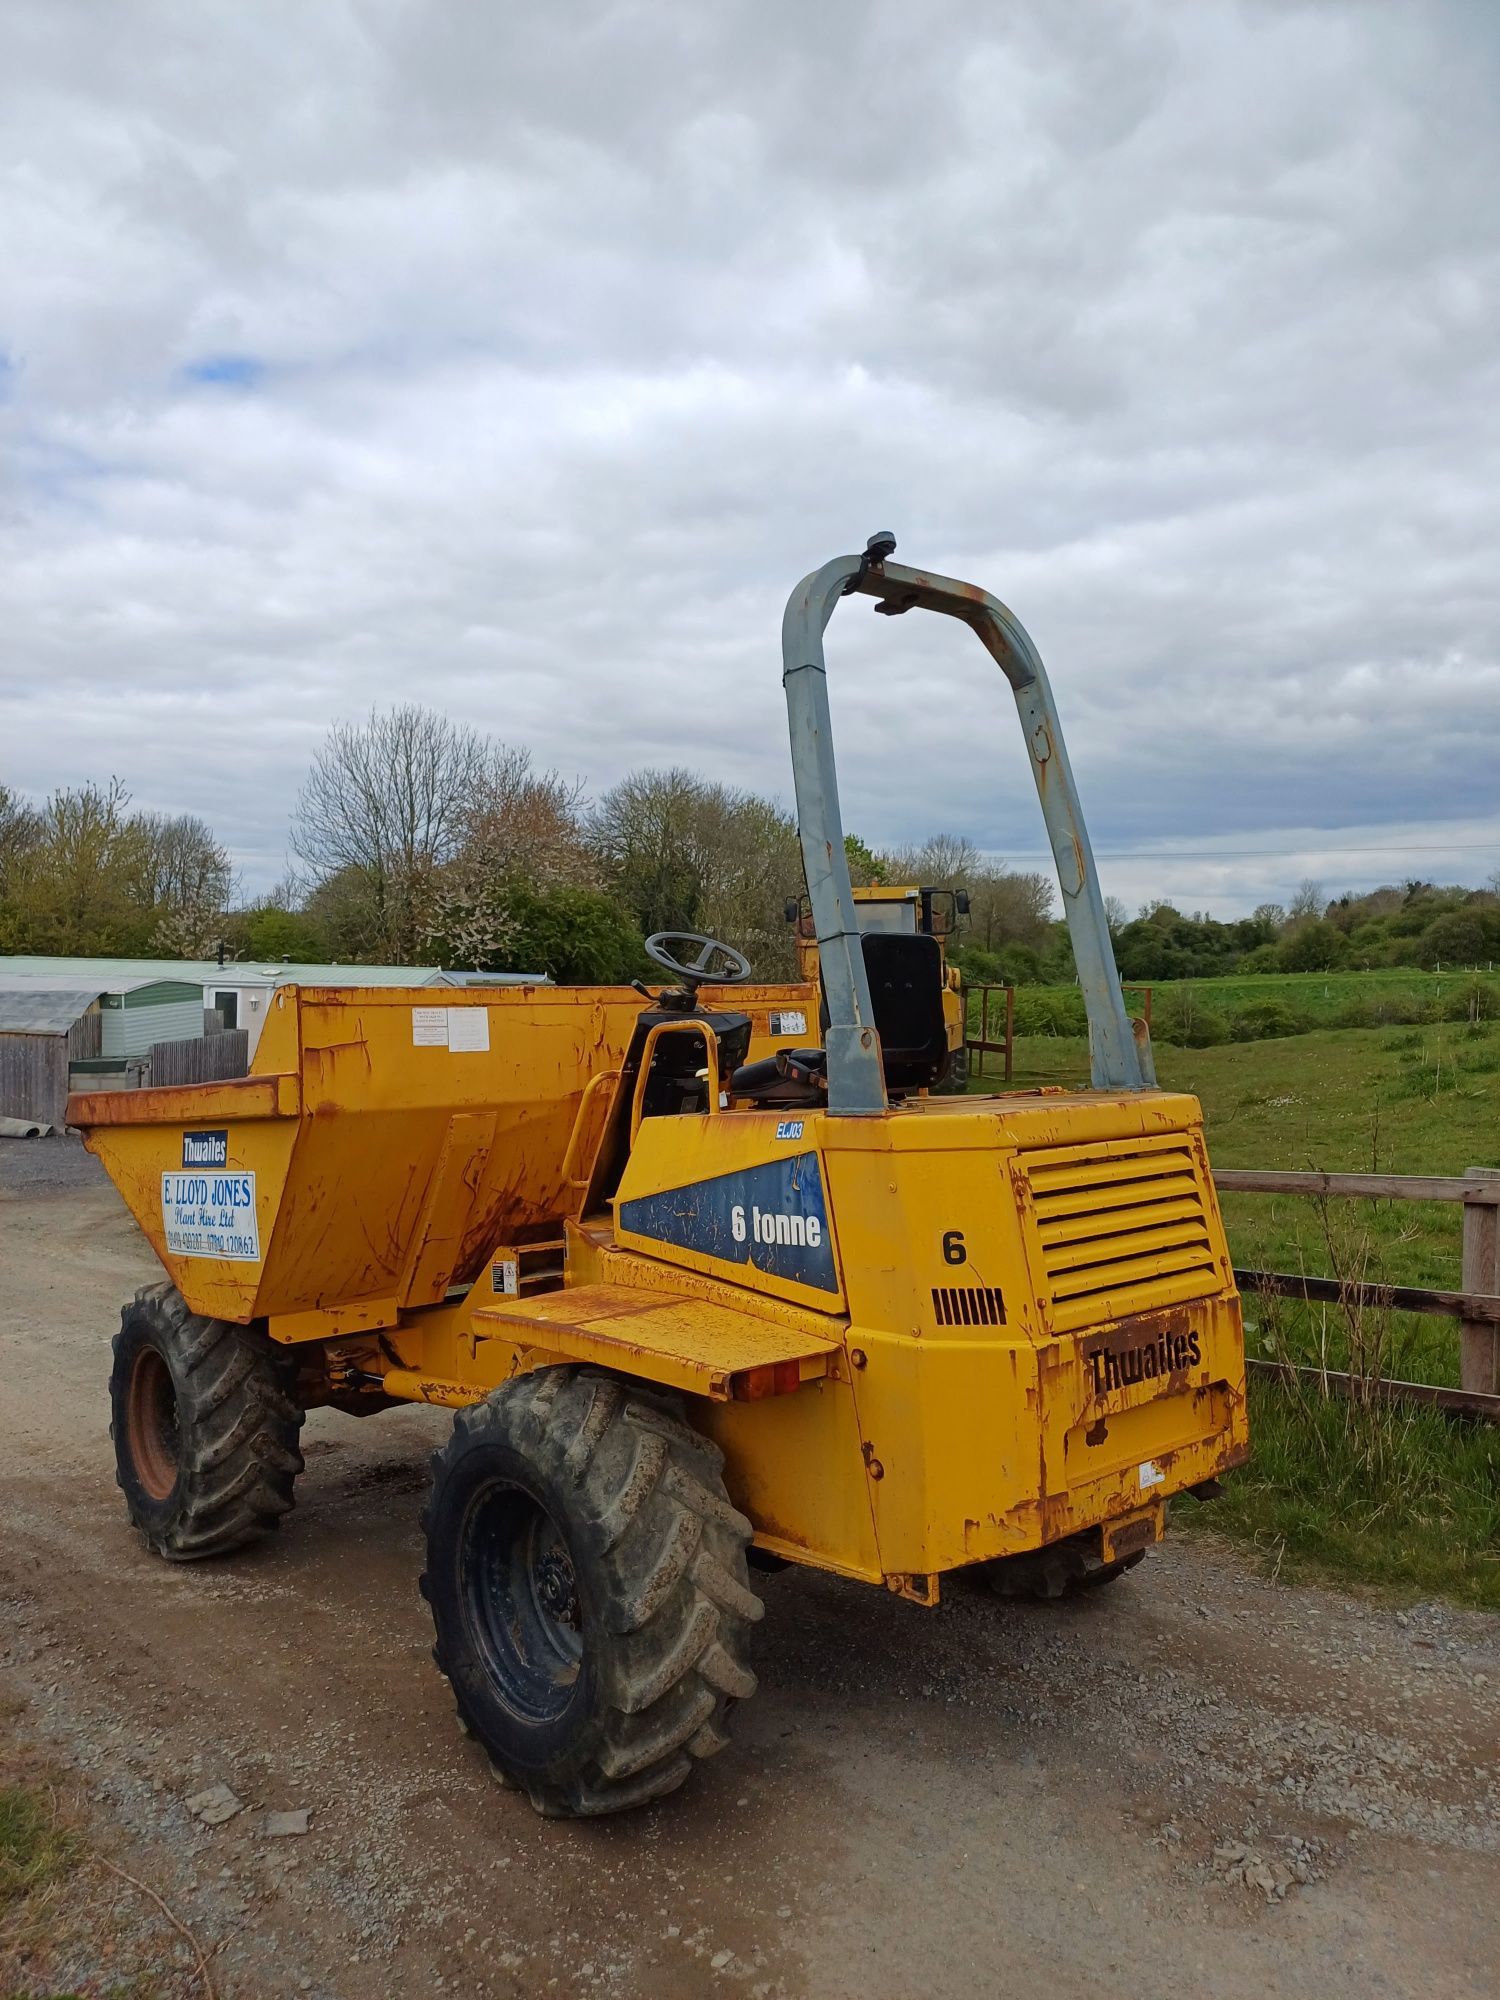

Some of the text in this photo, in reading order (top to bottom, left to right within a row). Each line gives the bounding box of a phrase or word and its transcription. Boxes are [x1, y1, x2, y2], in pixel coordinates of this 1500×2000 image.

[776, 1122, 803, 1138] ELJ03
[184, 1137, 226, 1162] Thwaites
[165, 1180, 251, 1207] E. LLOYD JONES
[175, 1206, 235, 1228] Plant Hire Ltd
[731, 1205, 821, 1248] 6 tonne
[942, 1231, 967, 1265] 6
[1089, 1331, 1201, 1396] Thwaites
